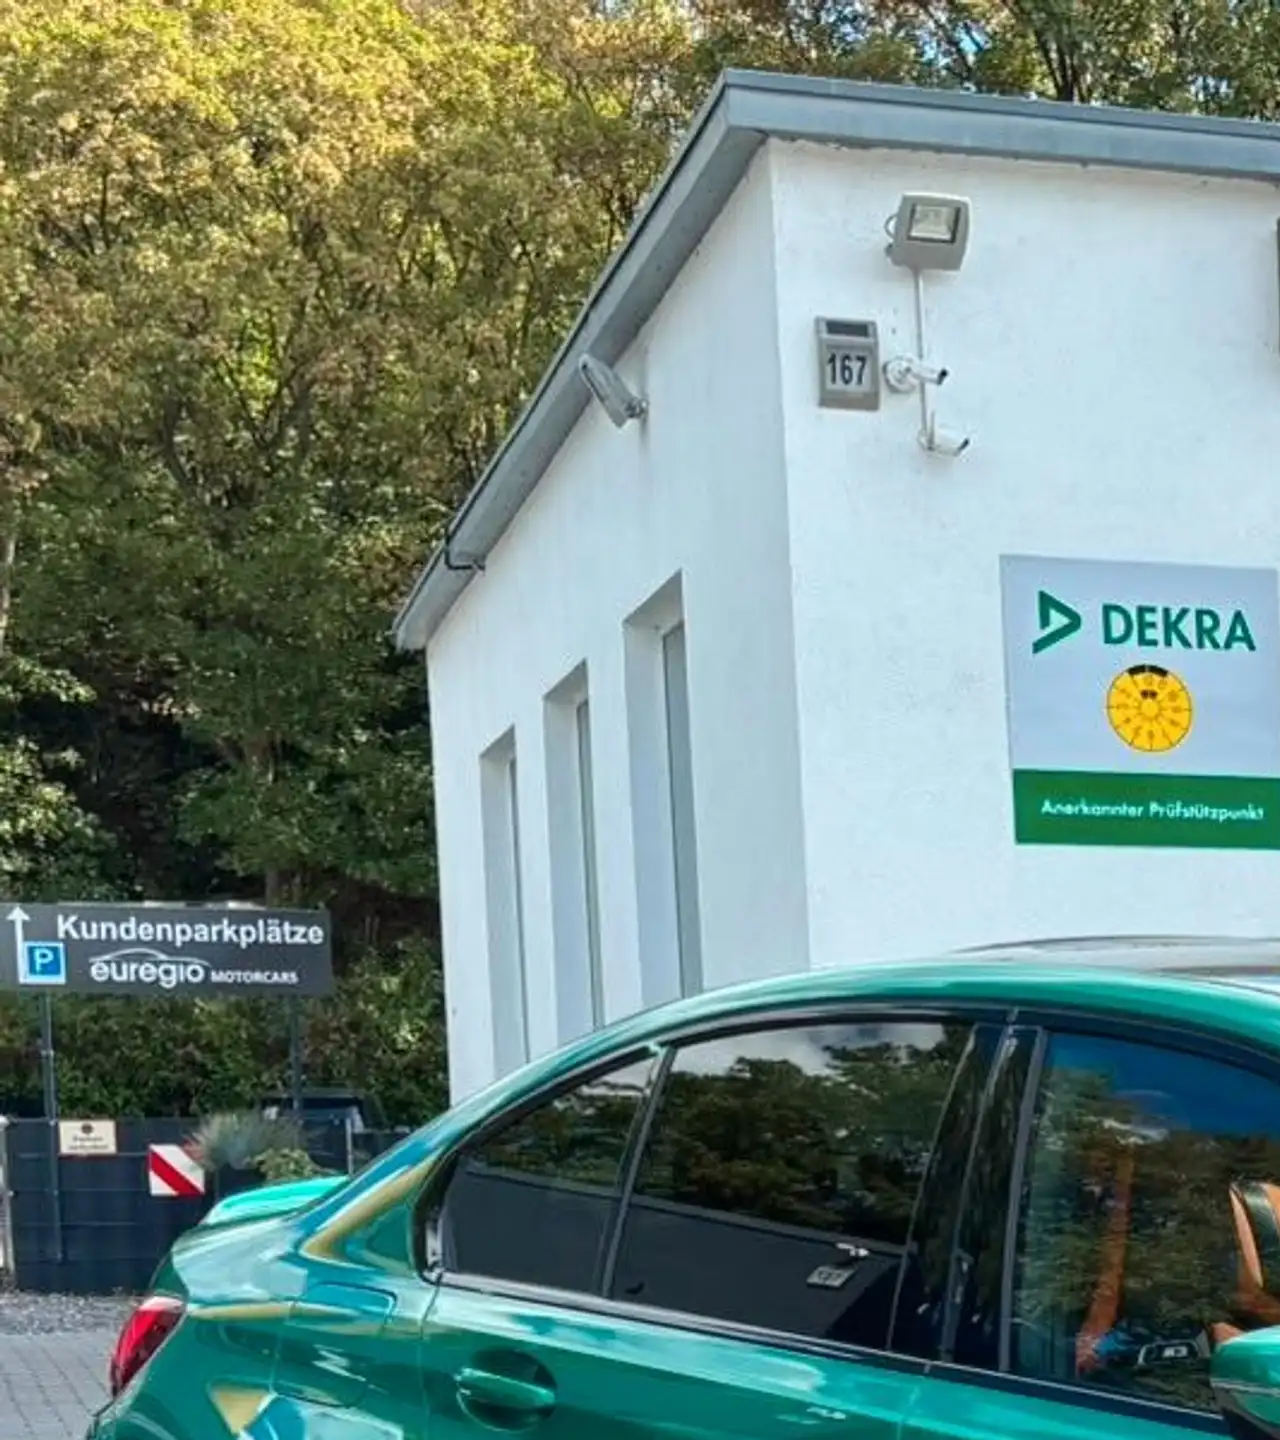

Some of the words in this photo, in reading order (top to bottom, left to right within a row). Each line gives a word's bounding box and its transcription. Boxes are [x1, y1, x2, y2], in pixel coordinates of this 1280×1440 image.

[827, 352, 867, 386] 167
[1101, 603, 1257, 651] DEKRA
[1040, 799, 1144, 818] Anerkannter
[1149, 801, 1265, 823] Prüfstützpunkt
[57, 914, 325, 949] Kundenparkplätze
[32, 948, 54, 973] P
[90, 957, 206, 988] euregio
[210, 970, 299, 984] MOTORCARS
